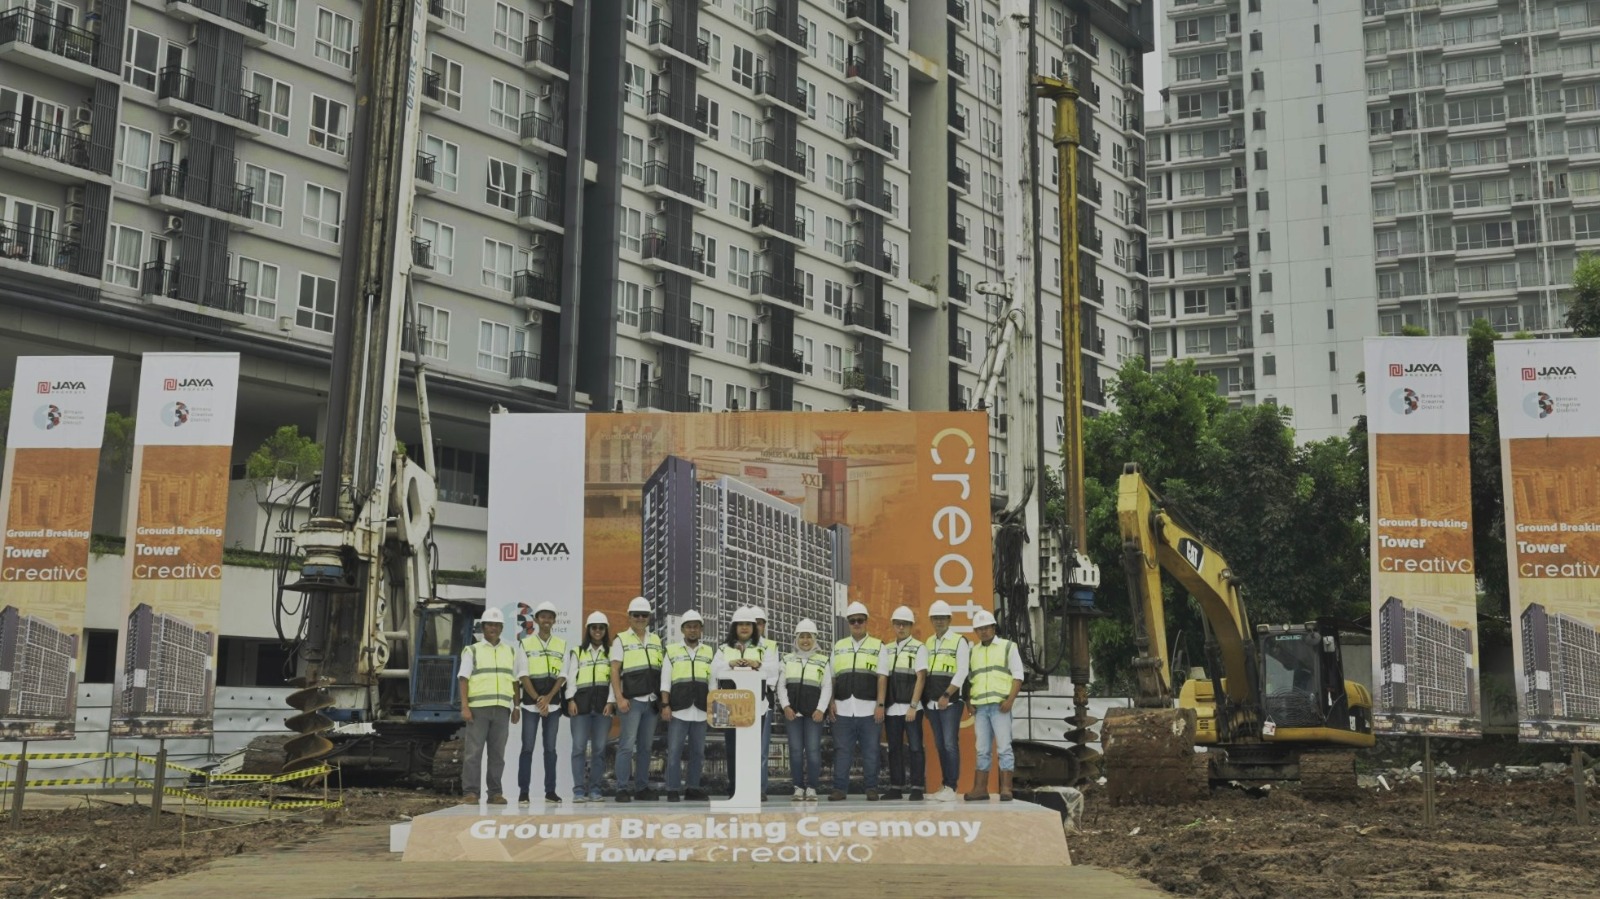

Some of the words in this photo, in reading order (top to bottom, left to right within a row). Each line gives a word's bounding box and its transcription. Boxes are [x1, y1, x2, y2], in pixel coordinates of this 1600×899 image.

[1404, 363, 1442, 373] JAYA
[1537, 366, 1577, 376] JAYA
[52, 381, 86, 390] JAYA
[178, 378, 214, 387] JAYA
[801, 472, 820, 487] XXI
[1378, 518, 1418, 527] Ground
[1420, 518, 1468, 530] Breaking
[1516, 523, 1557, 532] Ground
[1560, 523, 1600, 532] Breakin
[6, 529, 44, 538] Ground
[46, 529, 90, 539] Breaking
[137, 526, 175, 535] Ground
[177, 526, 223, 537] Breaking
[1378, 535, 1426, 549] Tower
[1517, 541, 1567, 554] Tower
[5, 546, 49, 558] Tower
[136, 543, 180, 556] Tower
[520, 542, 570, 555] JAYA
[1186, 540, 1198, 568] CAT
[1520, 562, 1600, 577] Creativ
[469, 817, 611, 839] Ground
[620, 817, 786, 843] Breaking
[796, 816, 982, 843] Ceremony
[581, 842, 695, 862] Tower
